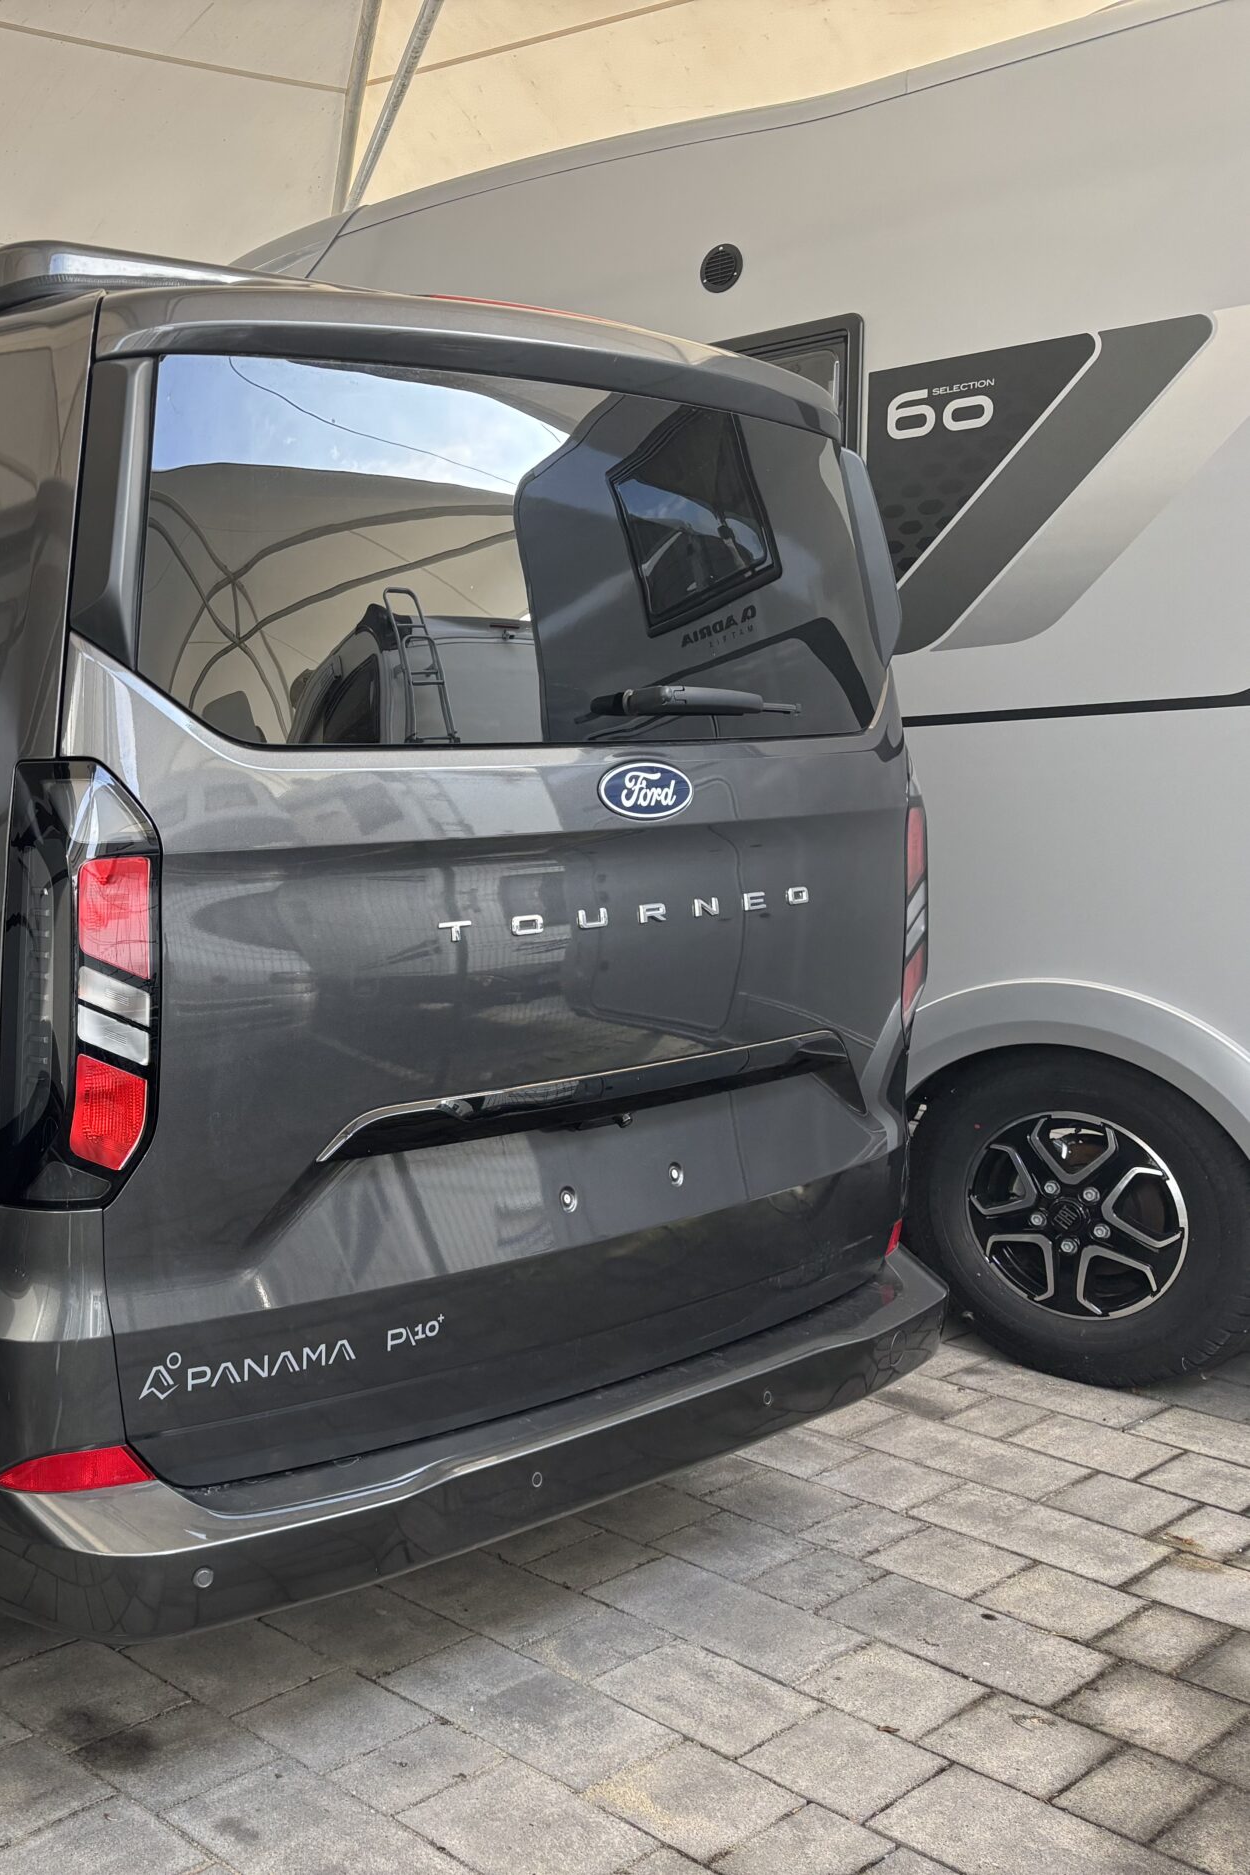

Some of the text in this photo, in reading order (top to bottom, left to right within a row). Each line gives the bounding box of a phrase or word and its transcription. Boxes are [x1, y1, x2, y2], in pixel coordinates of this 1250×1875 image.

[932, 378, 995, 396] SELECTION
[886, 388, 994, 440] 60
[620, 771, 677, 808] Ford
[438, 886, 810, 942] TOURNEO
[1053, 1204, 1078, 1230] FIAT
[187, 1339, 357, 1392] PANAMA
